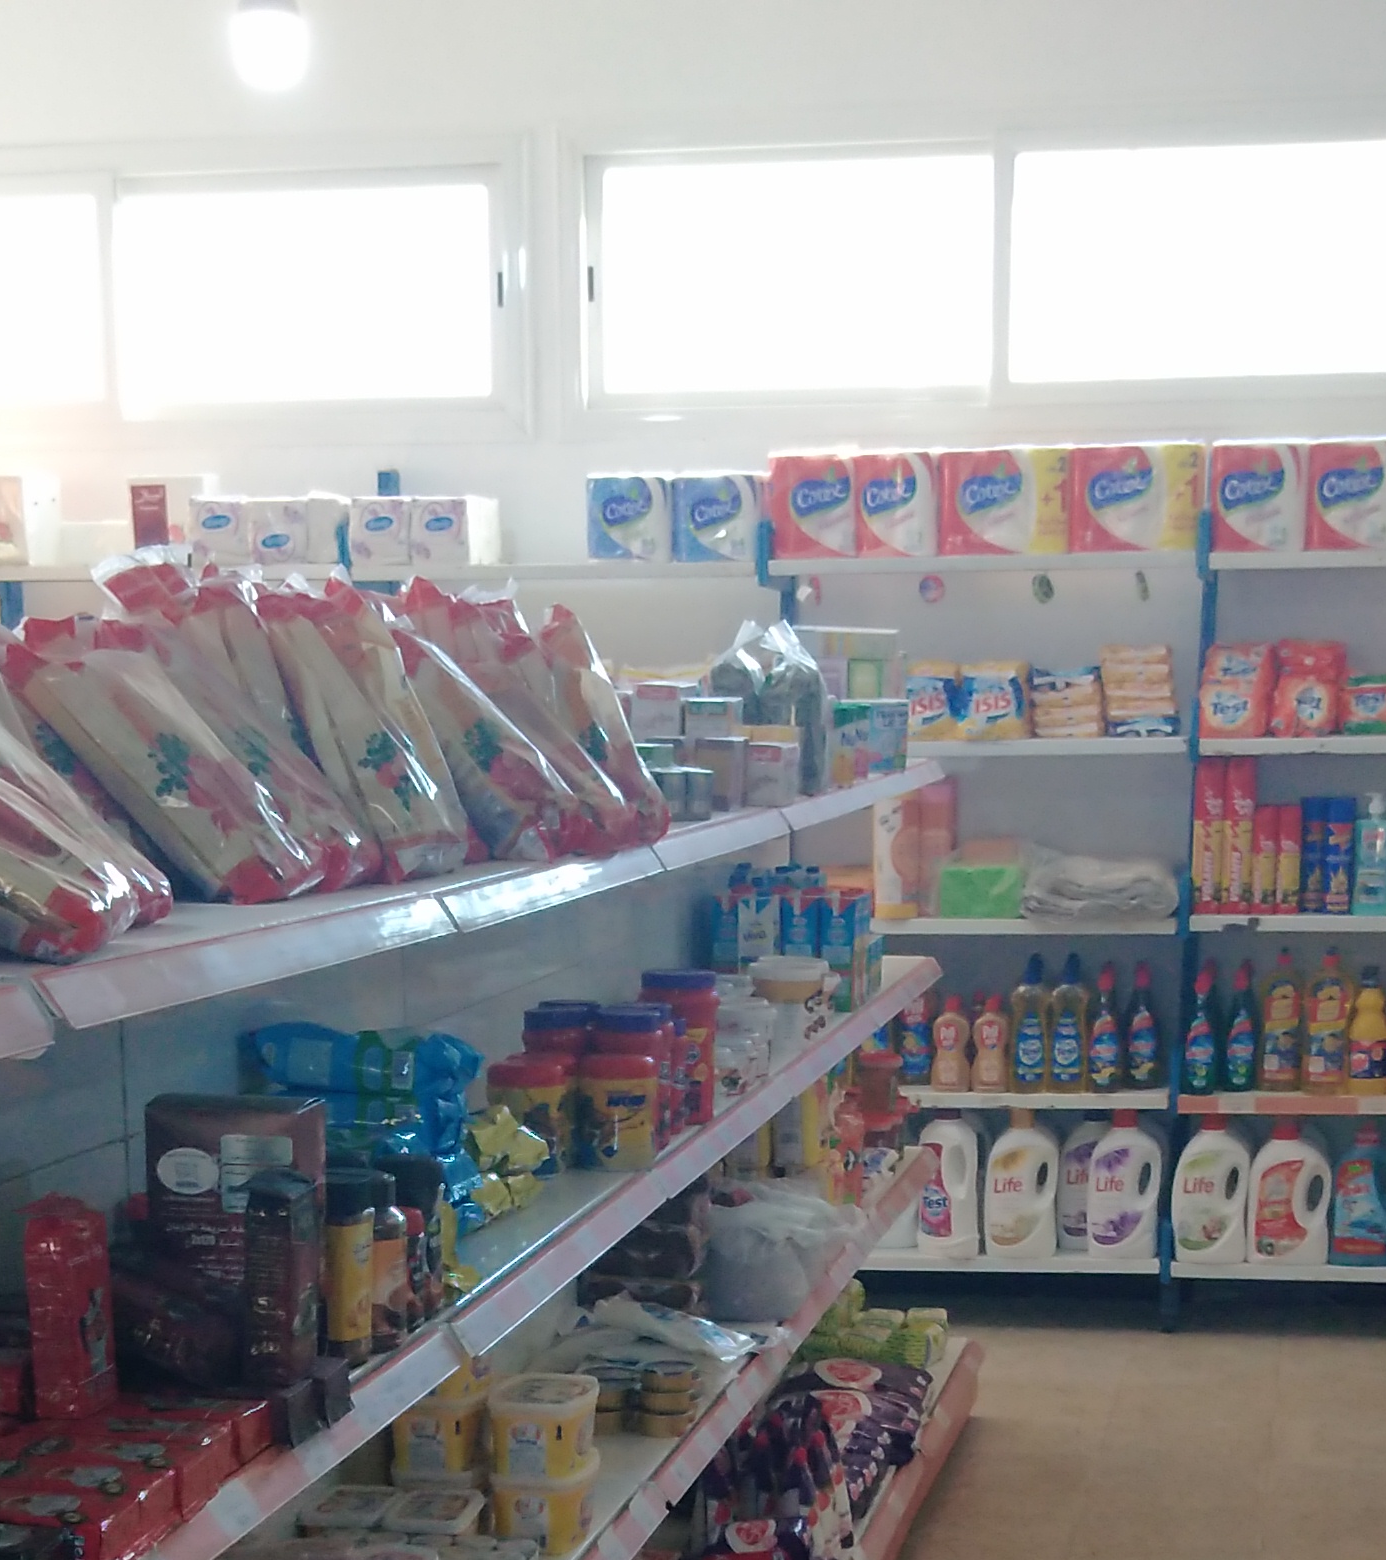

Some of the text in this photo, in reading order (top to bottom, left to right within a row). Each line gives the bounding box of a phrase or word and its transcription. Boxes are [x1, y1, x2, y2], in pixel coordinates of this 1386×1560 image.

[910, 693, 945, 716] ISIS
[974, 691, 1012, 715] ISIS
[993, 1177, 1024, 1194] Life
[1066, 1168, 1089, 1185] Lif
[1095, 1173, 1125, 1193] Life
[1182, 1177, 1215, 1195] Life
